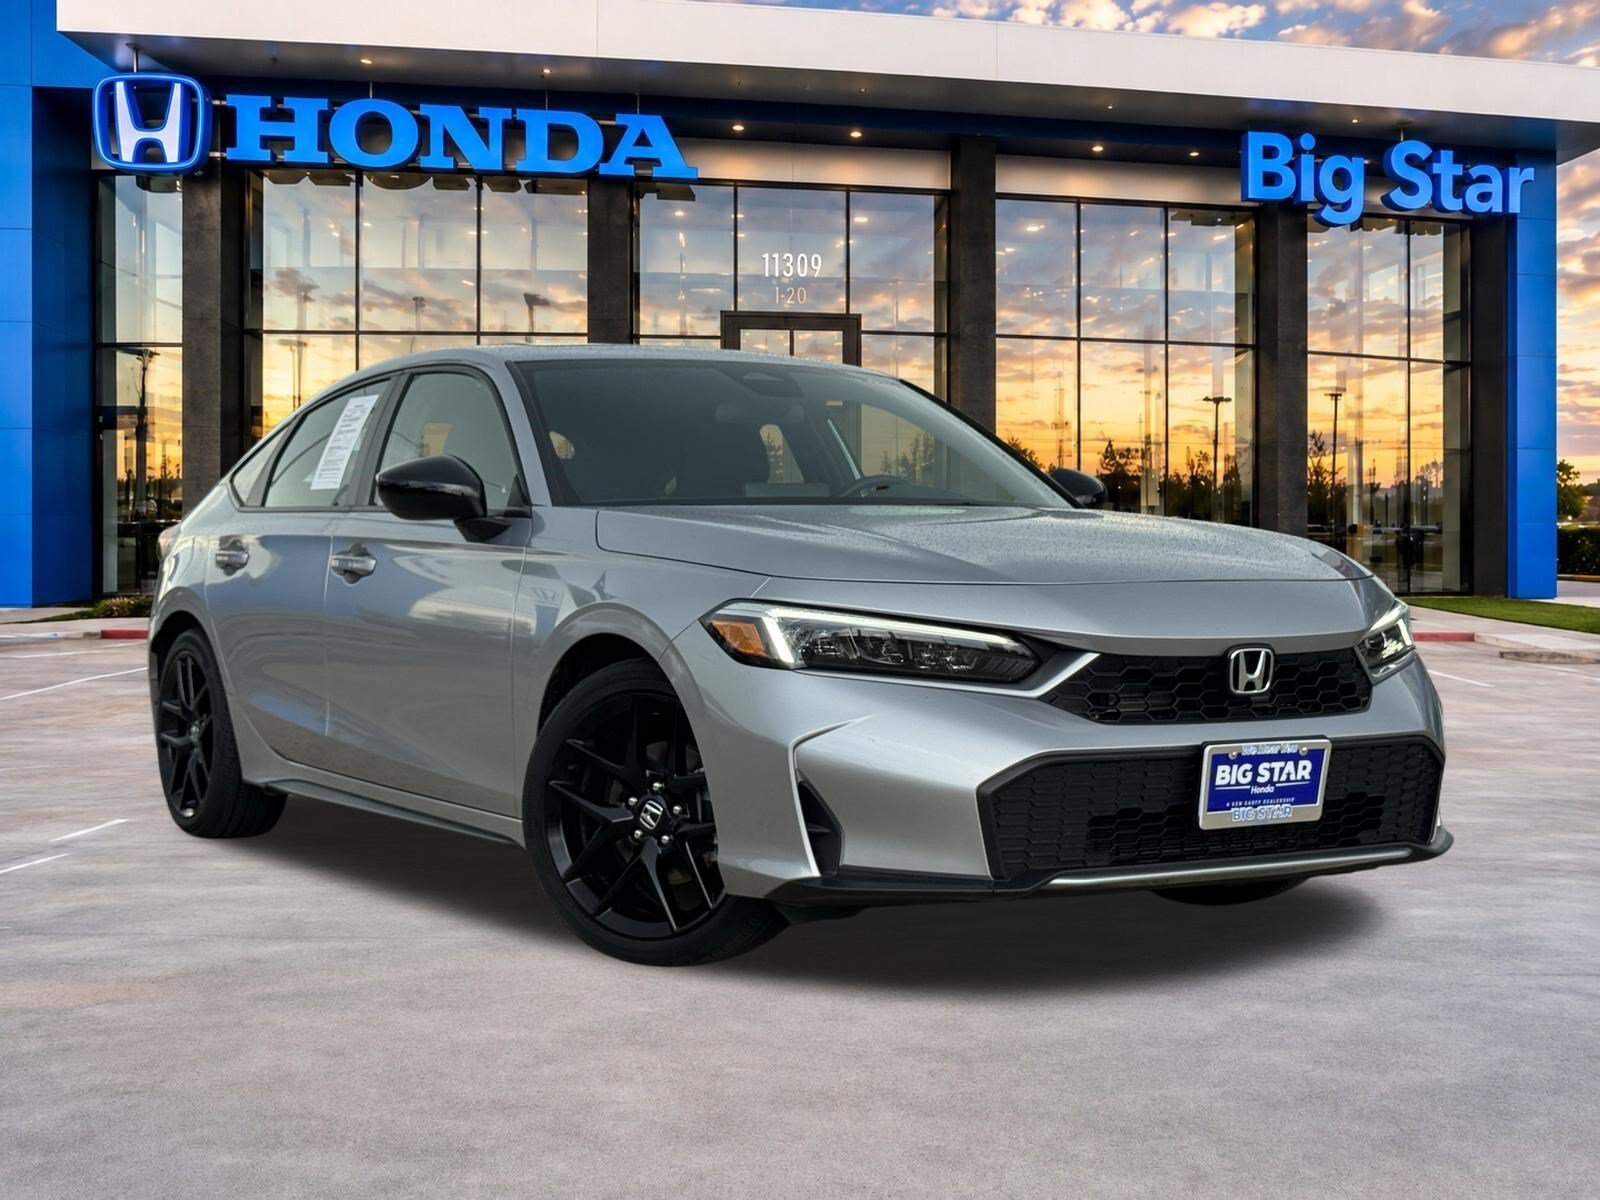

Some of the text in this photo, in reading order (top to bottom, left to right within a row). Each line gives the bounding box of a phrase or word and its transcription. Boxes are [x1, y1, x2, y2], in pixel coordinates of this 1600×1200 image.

[225, 94, 698, 180] HONDA
[1242, 131, 1535, 226] Big Star
[761, 252, 822, 277] 11309
[1215, 760, 1313, 786] BIG STAR
[1250, 785, 1275, 795] Honda
[1232, 804, 1293, 821] BIG STAR
